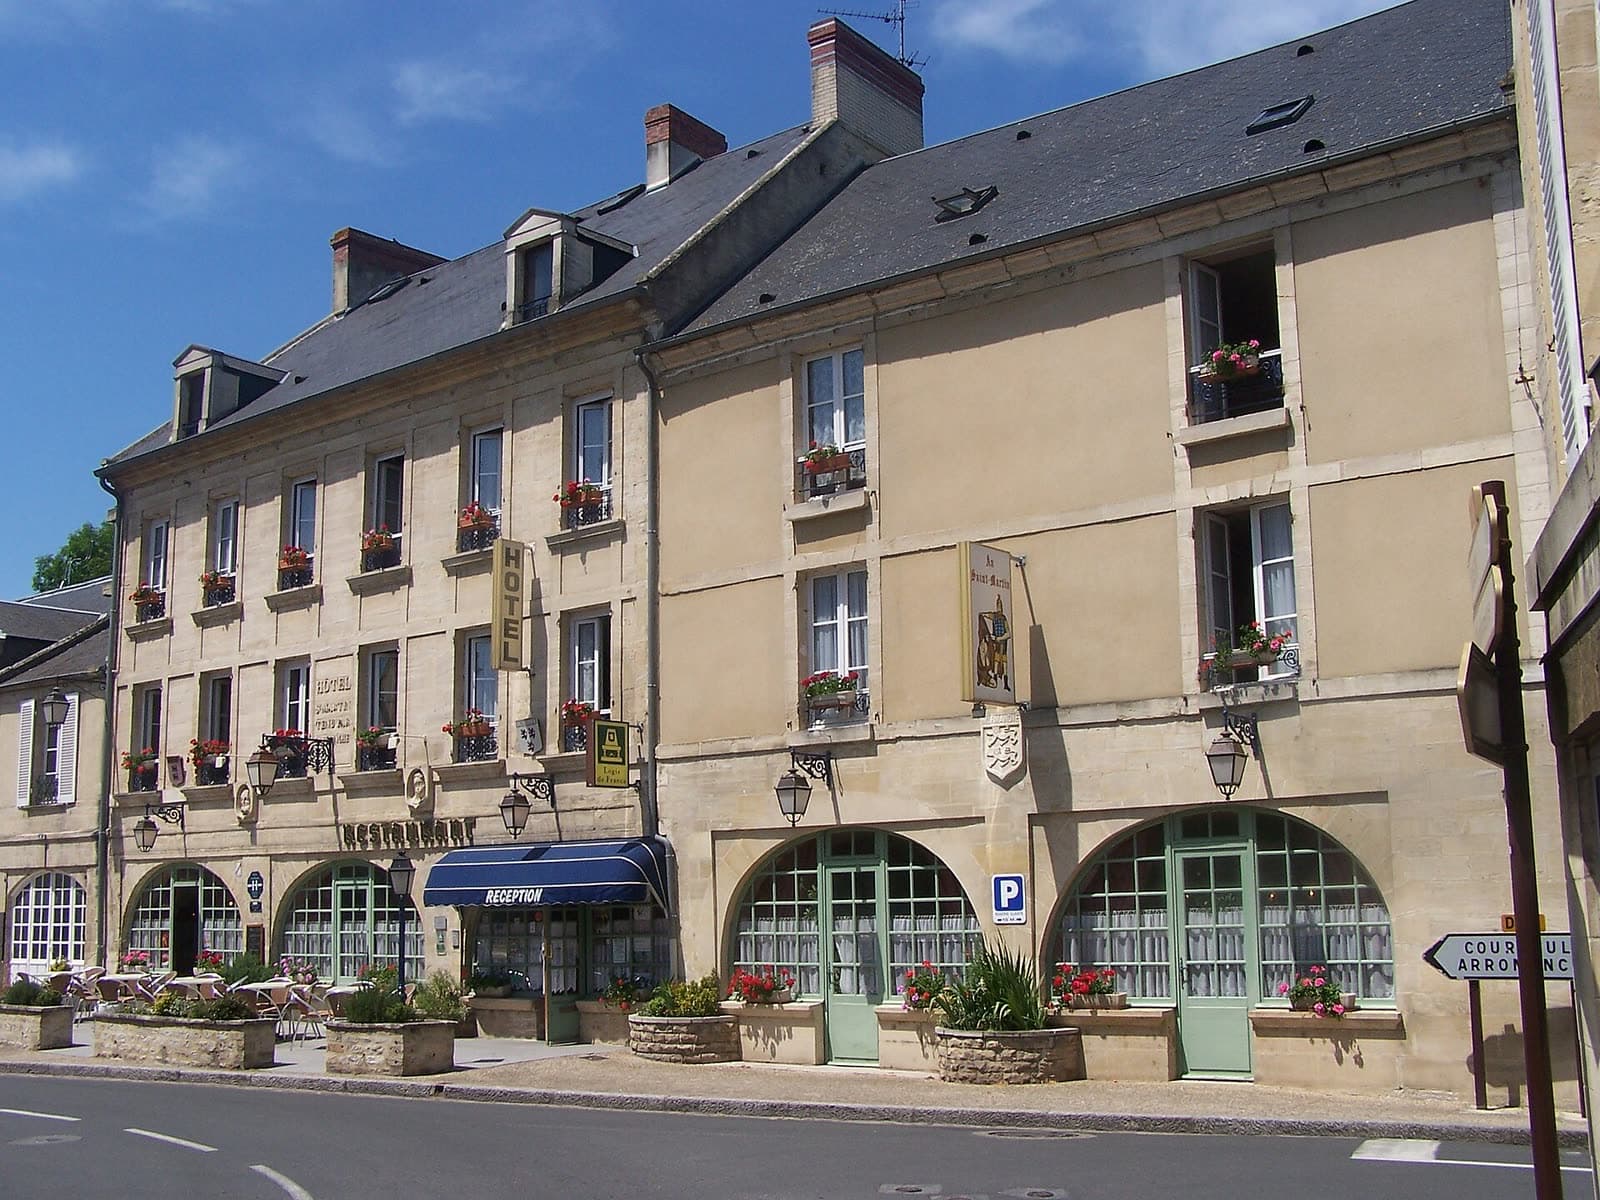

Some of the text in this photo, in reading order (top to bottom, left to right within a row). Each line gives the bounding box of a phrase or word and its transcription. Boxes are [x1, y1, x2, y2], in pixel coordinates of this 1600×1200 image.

[504, 547, 520, 662] HOTEL
[485, 888, 543, 903] RECEPTION
[1000, 880, 1019, 908] P
